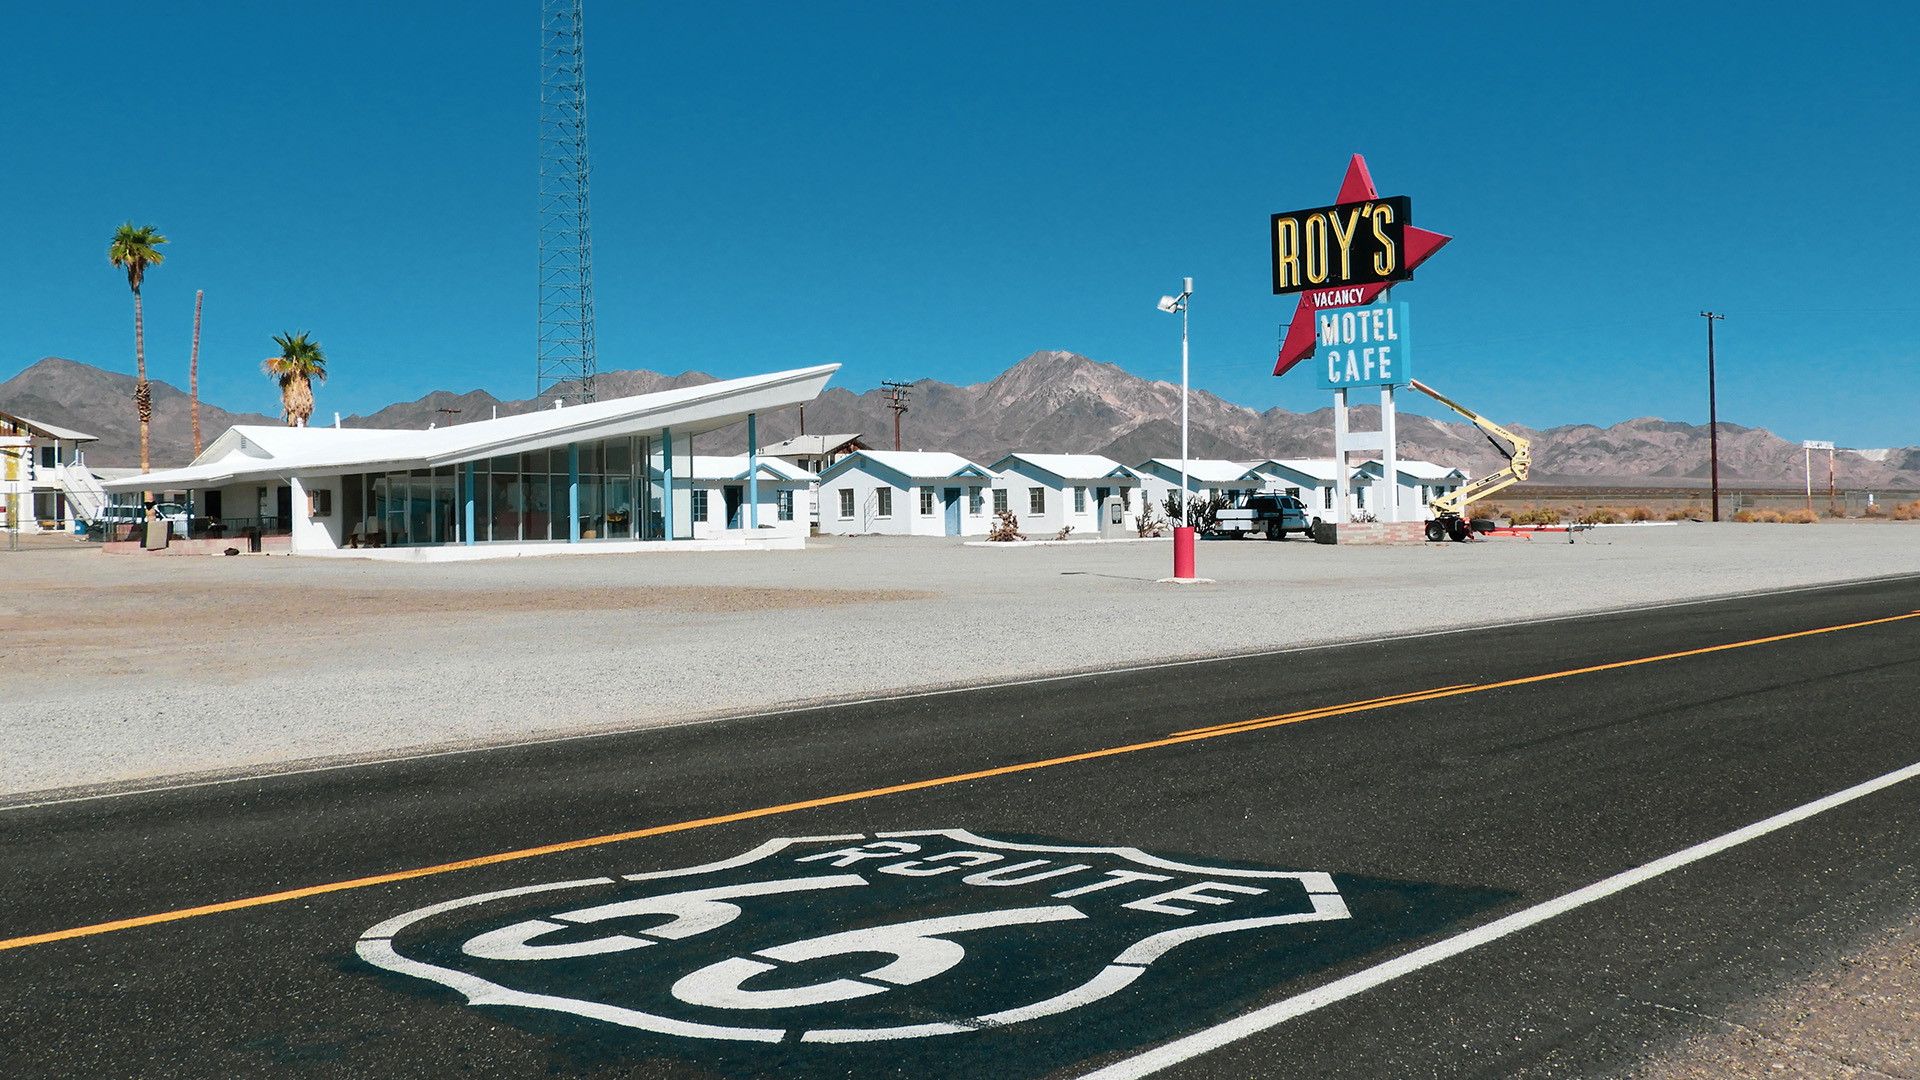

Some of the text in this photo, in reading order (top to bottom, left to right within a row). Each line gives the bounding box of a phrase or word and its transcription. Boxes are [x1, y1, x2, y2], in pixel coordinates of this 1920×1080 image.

[1278, 203, 1394, 288] ROY'S
[1313, 288, 1364, 308] VACANCY
[1321, 308, 1398, 346] MOTEL
[1328, 346, 1391, 383] CAFE
[794, 841, 1269, 916] ROUTE
[462, 874, 1089, 1009] 66
